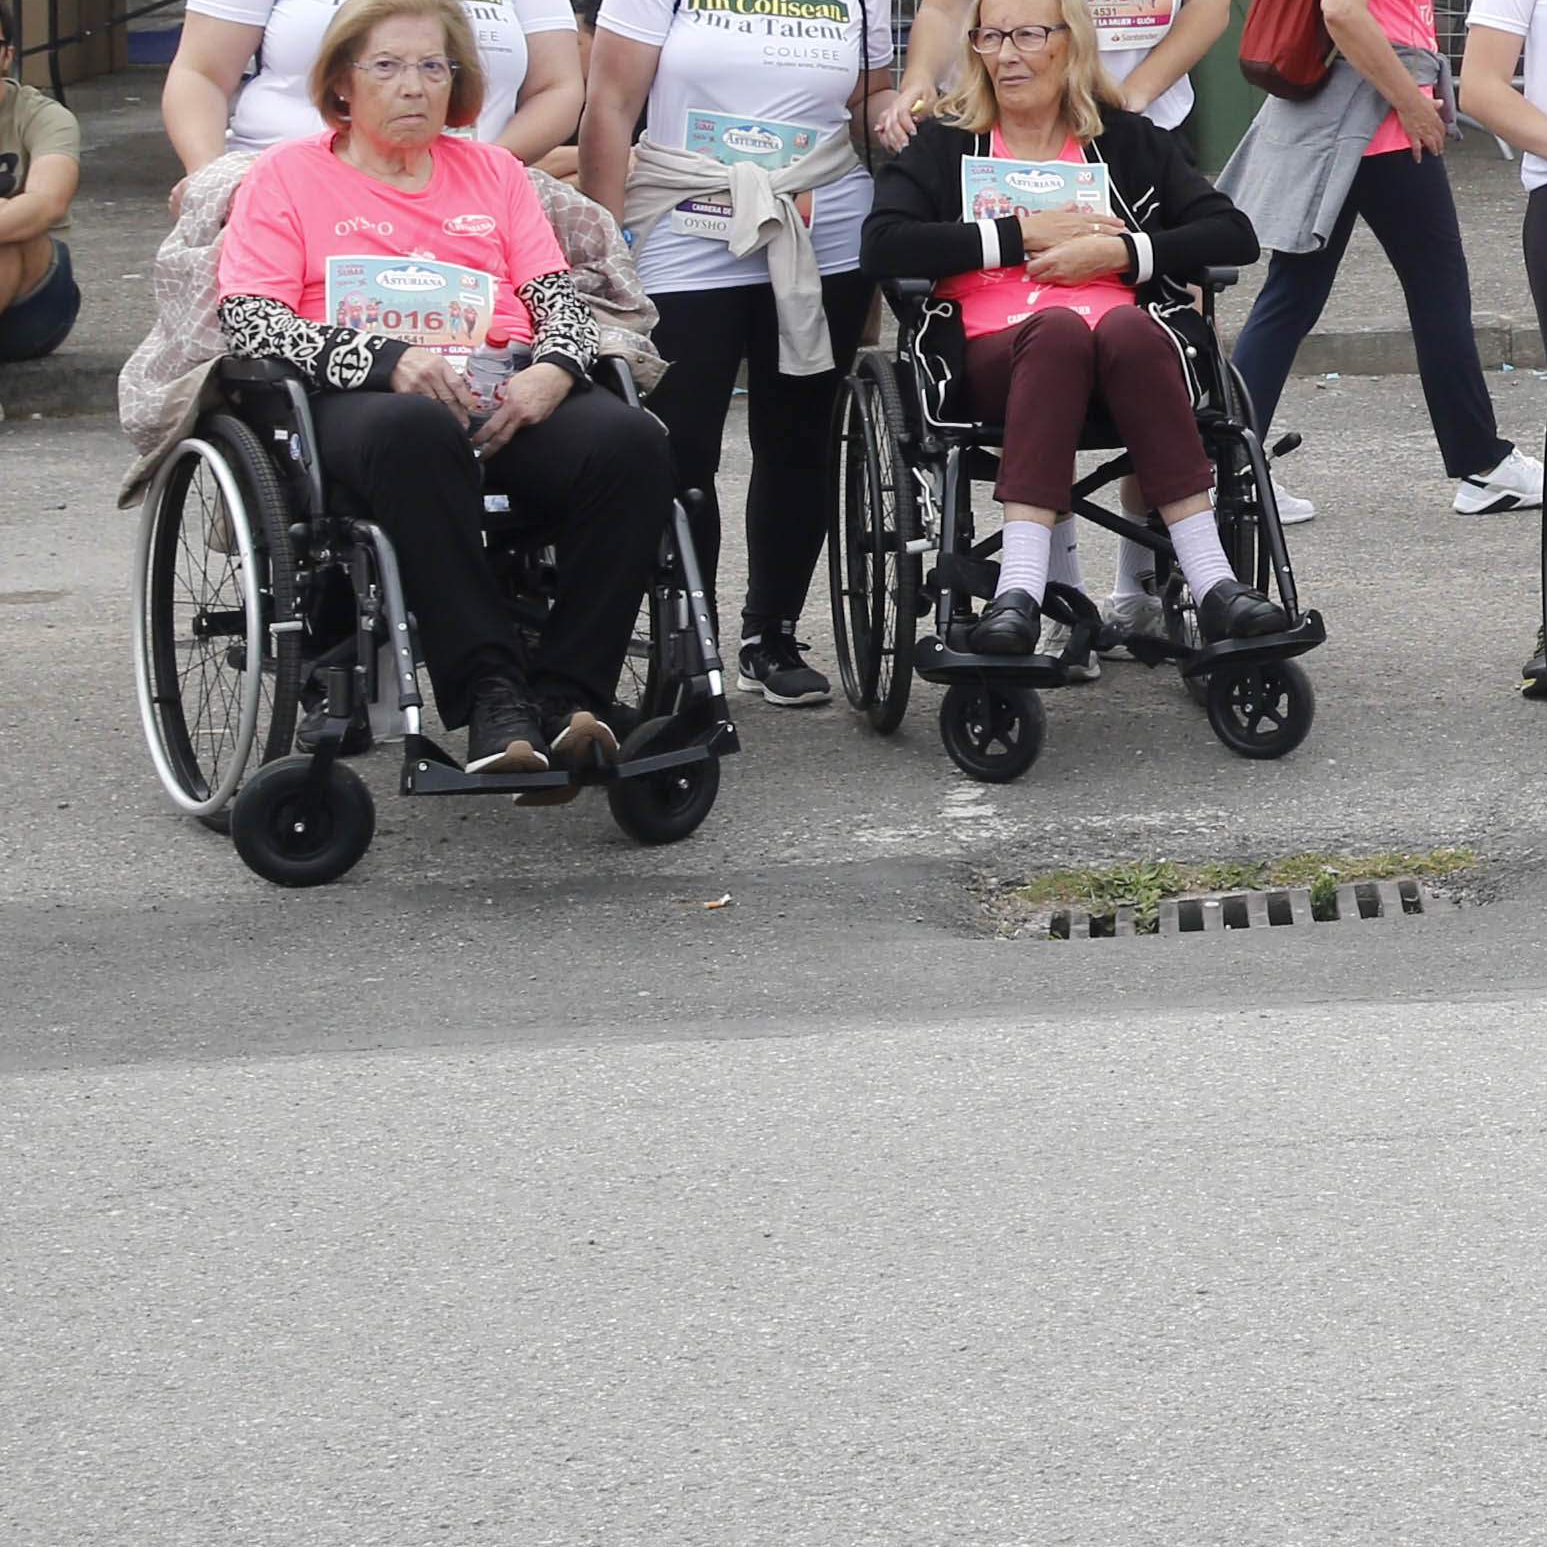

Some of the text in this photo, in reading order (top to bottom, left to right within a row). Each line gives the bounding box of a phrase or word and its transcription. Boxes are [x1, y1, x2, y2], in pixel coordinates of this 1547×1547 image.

[1093, 7, 1117, 16] 4531
[738, 21, 752, 34] a
[763, 45, 840, 62] COLISEE
[1077, 171, 1093, 183] 20
[335, 214, 394, 237] OYSO
[683, 216, 727, 232] OYSHO
[381, 274, 443, 288] ASTURIANA
[382, 309, 444, 330] 016
